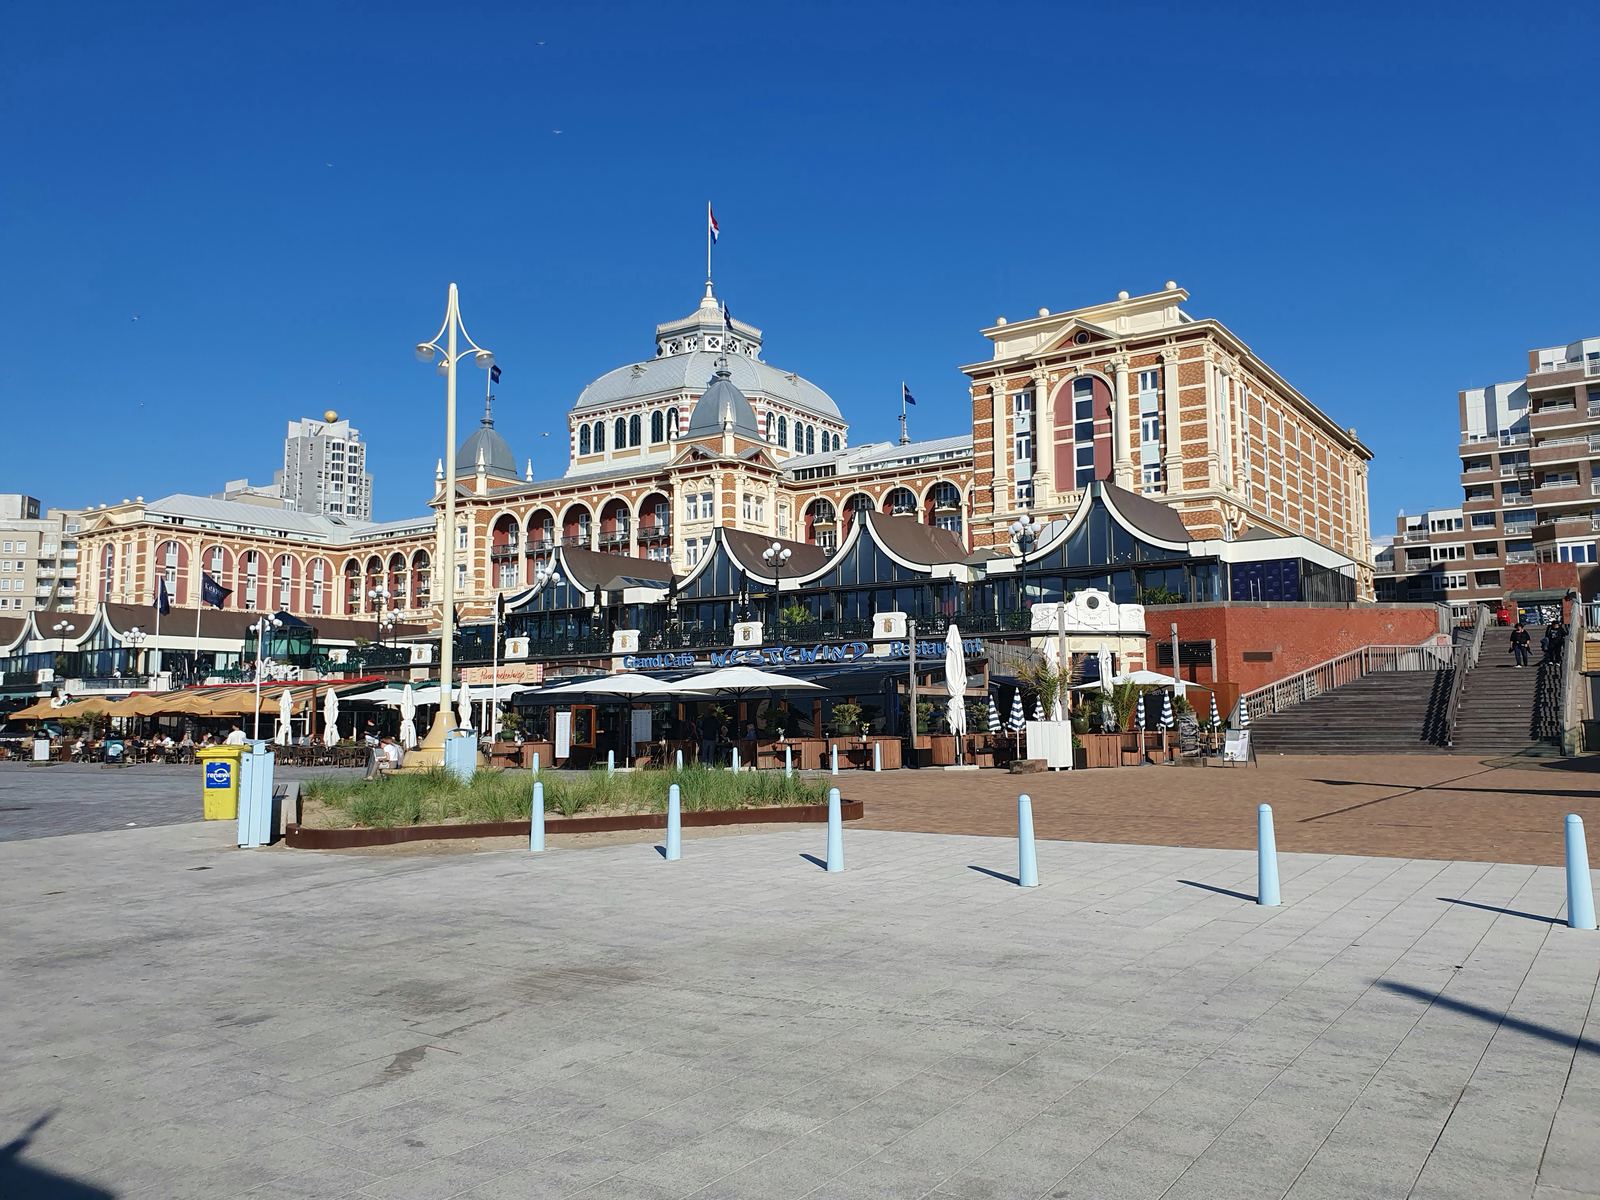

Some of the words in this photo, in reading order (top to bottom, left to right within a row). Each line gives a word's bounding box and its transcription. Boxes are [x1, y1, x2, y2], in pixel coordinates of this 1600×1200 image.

[623, 654, 661, 669] Grand
[664, 653, 694, 668] Café
[711, 641, 868, 668] WESTEWIND
